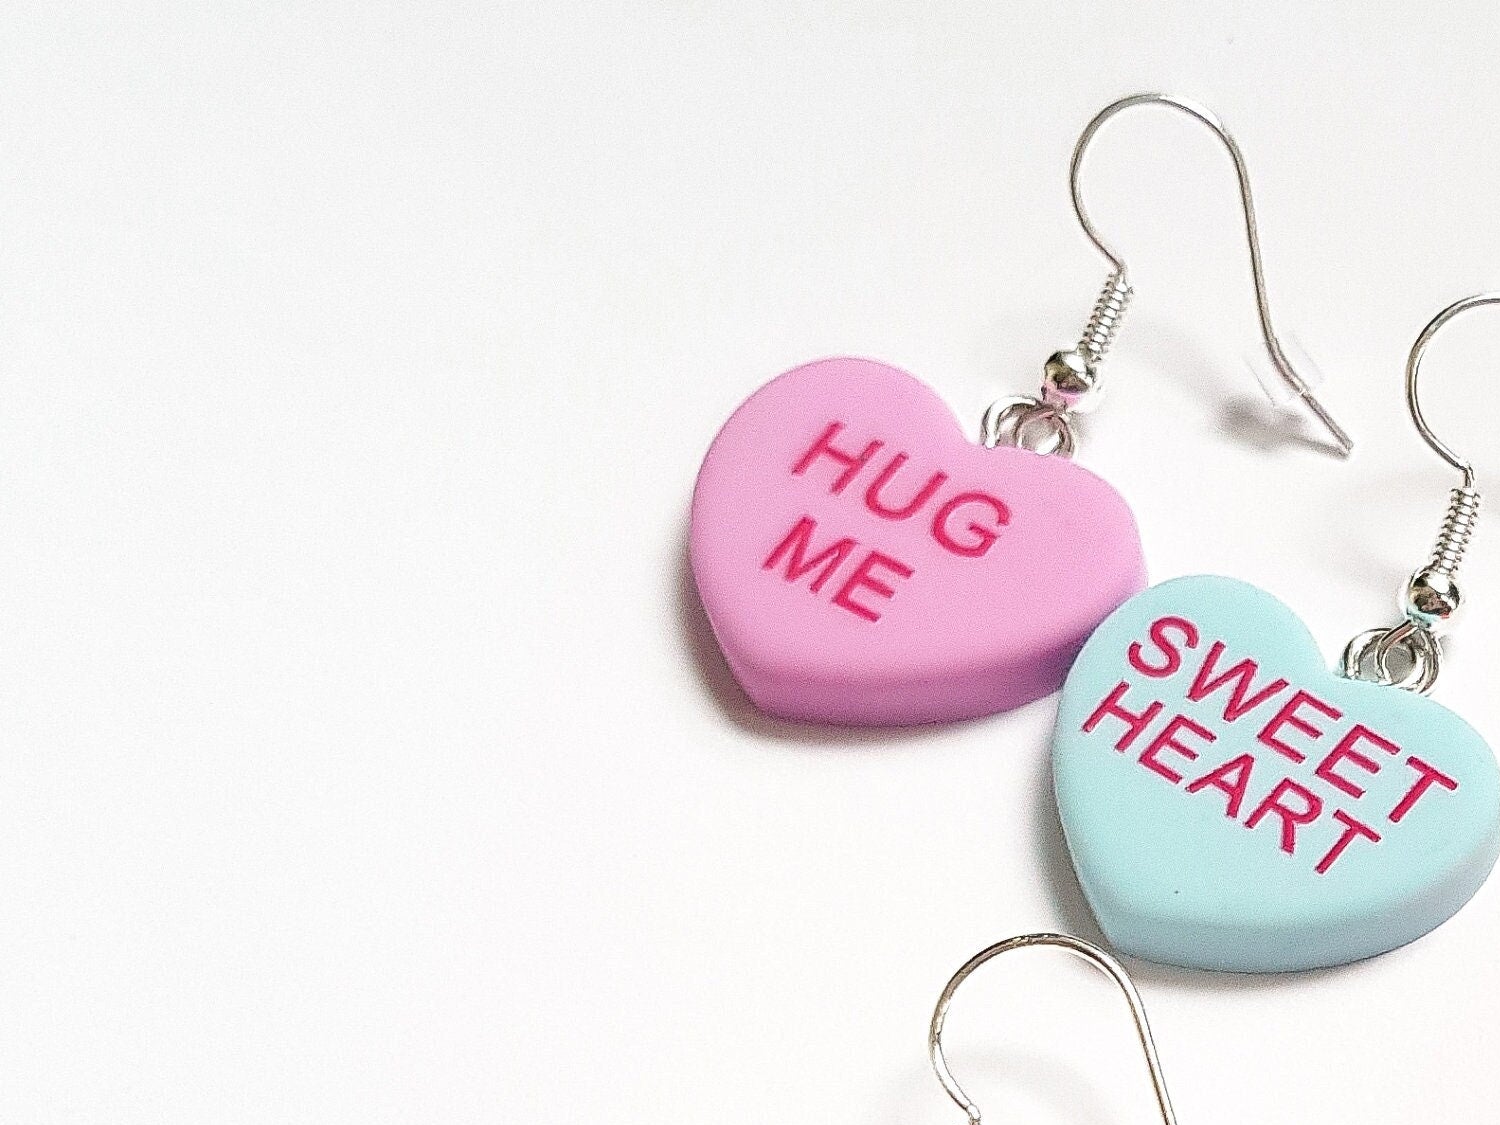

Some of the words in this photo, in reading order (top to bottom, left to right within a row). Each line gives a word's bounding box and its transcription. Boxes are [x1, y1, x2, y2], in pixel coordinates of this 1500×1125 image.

[761, 516, 915, 623] ME
[791, 420, 1012, 557] HUG
[1081, 681, 1382, 874] HEART
[1127, 616, 1459, 823] SWEET
